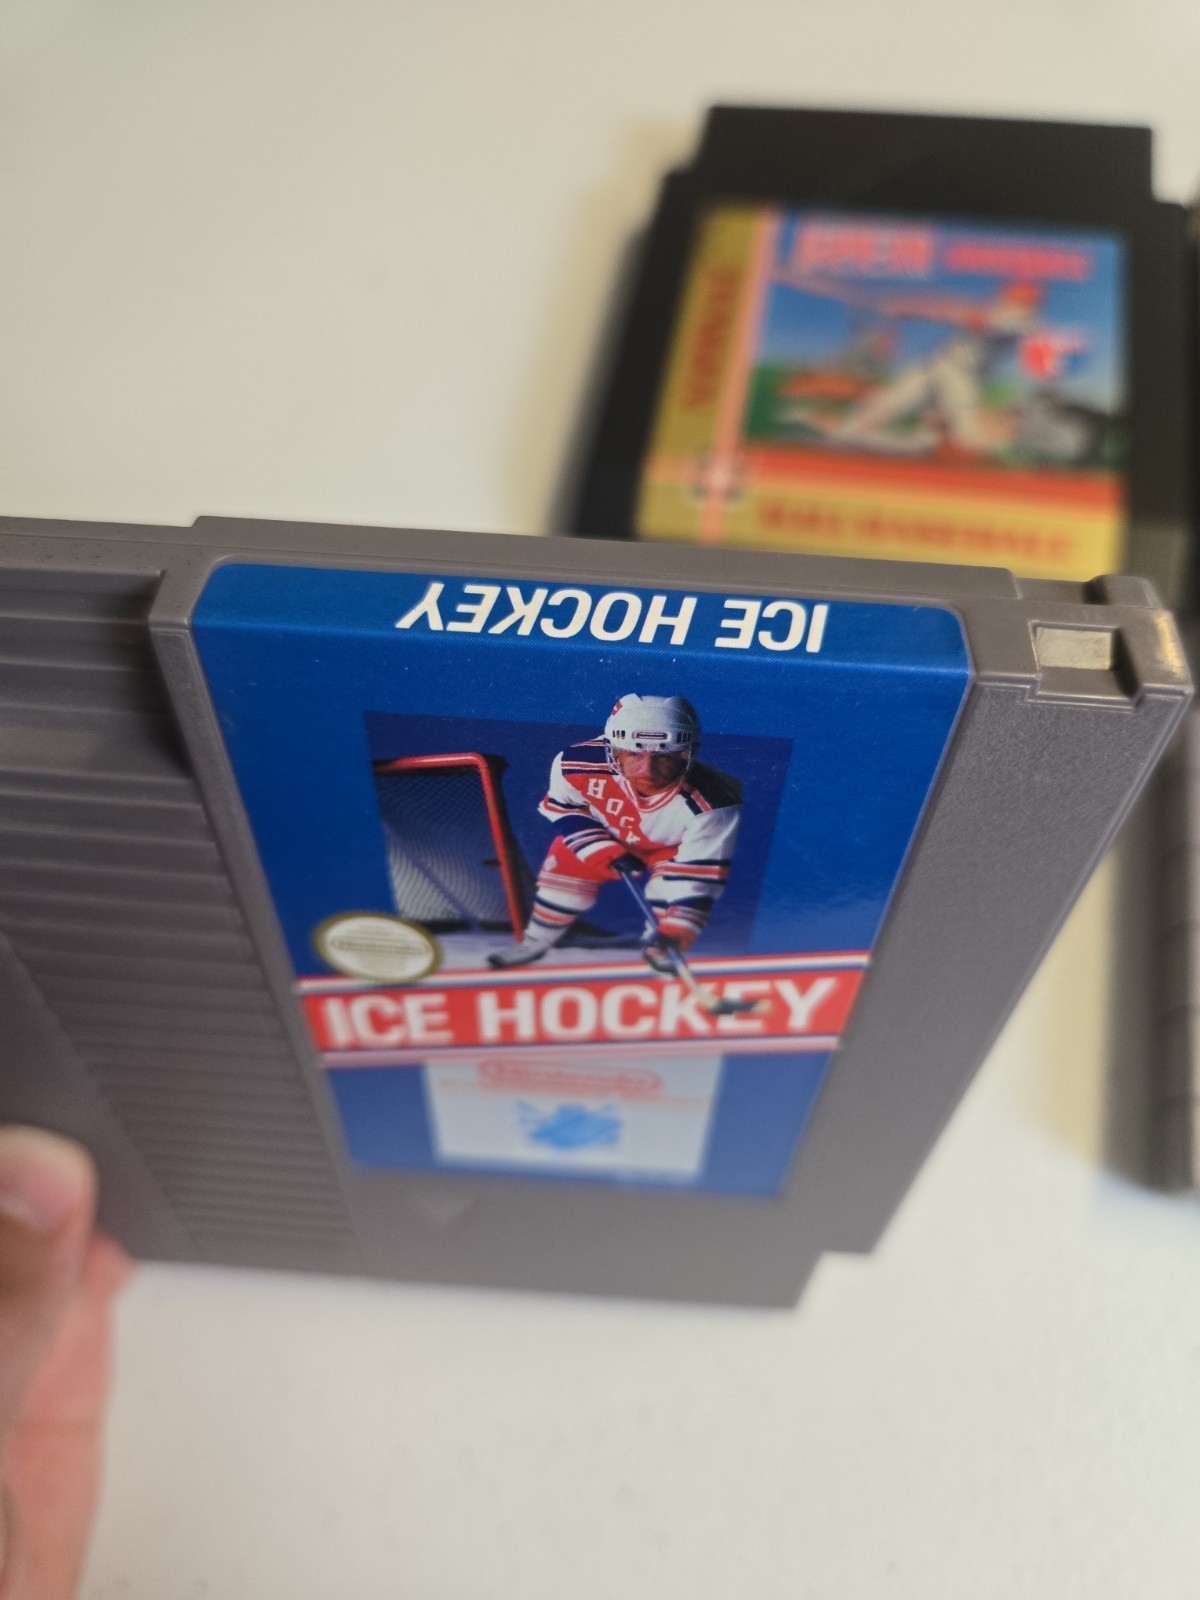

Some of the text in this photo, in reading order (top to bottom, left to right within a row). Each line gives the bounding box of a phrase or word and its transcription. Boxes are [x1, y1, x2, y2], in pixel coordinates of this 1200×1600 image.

[395, 582, 829, 653] ICE HOCKEY
[322, 976, 838, 1046] ICE HOCKEY
